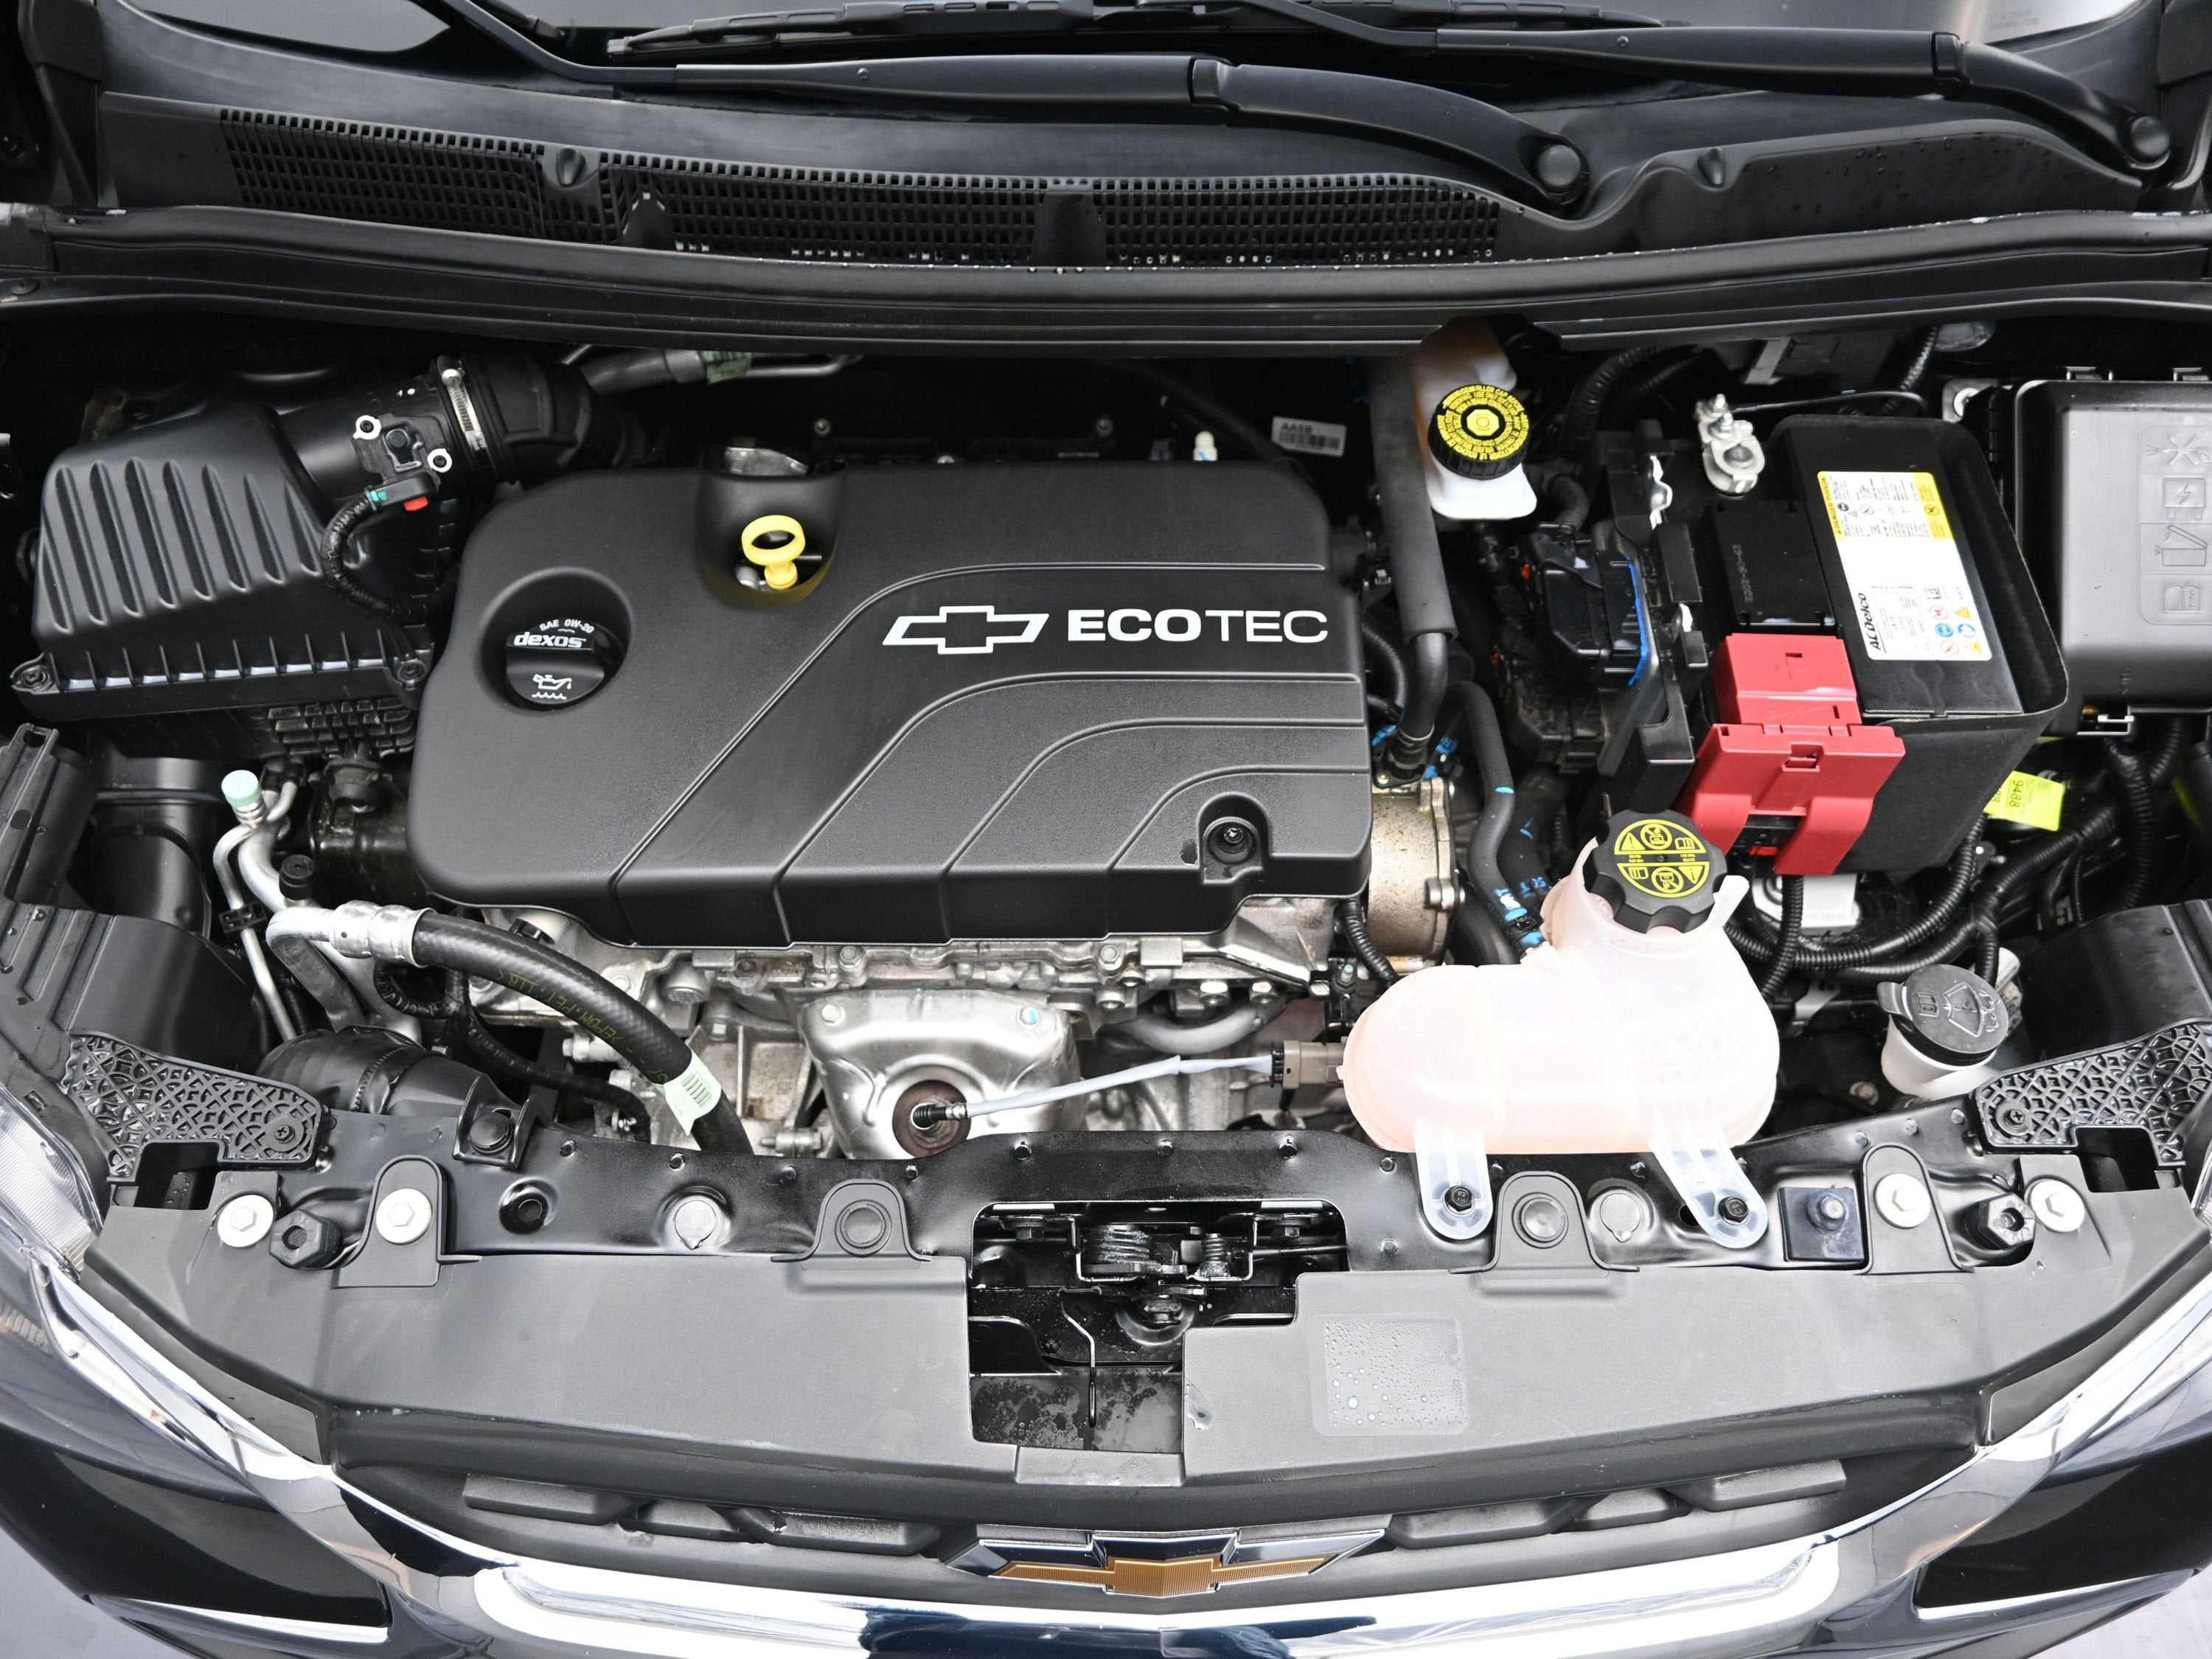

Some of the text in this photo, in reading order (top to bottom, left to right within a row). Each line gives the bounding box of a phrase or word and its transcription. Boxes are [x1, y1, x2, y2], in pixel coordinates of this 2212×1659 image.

[1495, 389, 1507, 397] CAP
[539, 619, 560, 632] SAE
[1068, 608, 1329, 643] ECOTEC
[1858, 592, 1881, 650] ACDelco
[513, 631, 587, 648] dexos
